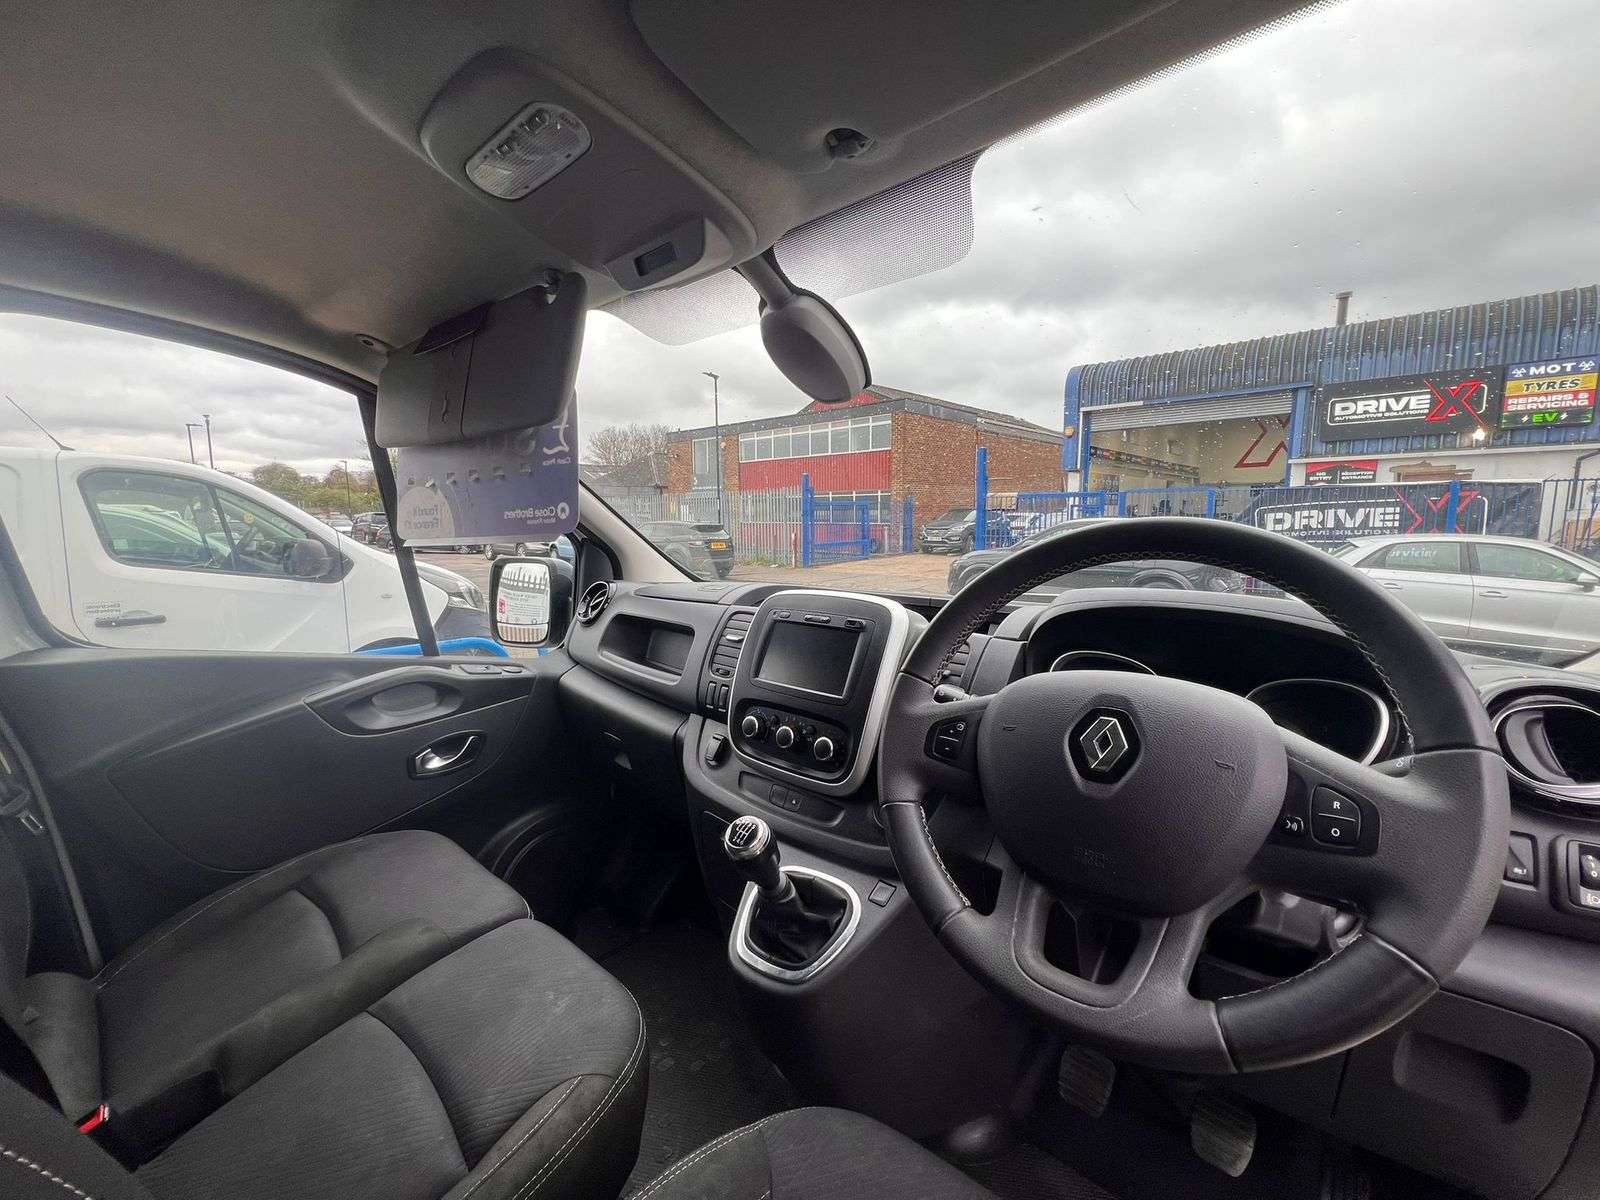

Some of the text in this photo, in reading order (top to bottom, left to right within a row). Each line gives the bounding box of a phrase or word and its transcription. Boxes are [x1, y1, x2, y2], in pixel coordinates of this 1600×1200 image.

[1529, 362, 1577, 376] MOT
[1523, 379, 1581, 392] TYRES
[1507, 394, 1575, 405] REPAIRS
[1506, 400, 1589, 412] SERVICING
[1334, 408, 1430, 421] AUTOMOTIVE SOLUTIONS
[1532, 412, 1559, 424] EV
[1333, 801, 1340, 809] R
